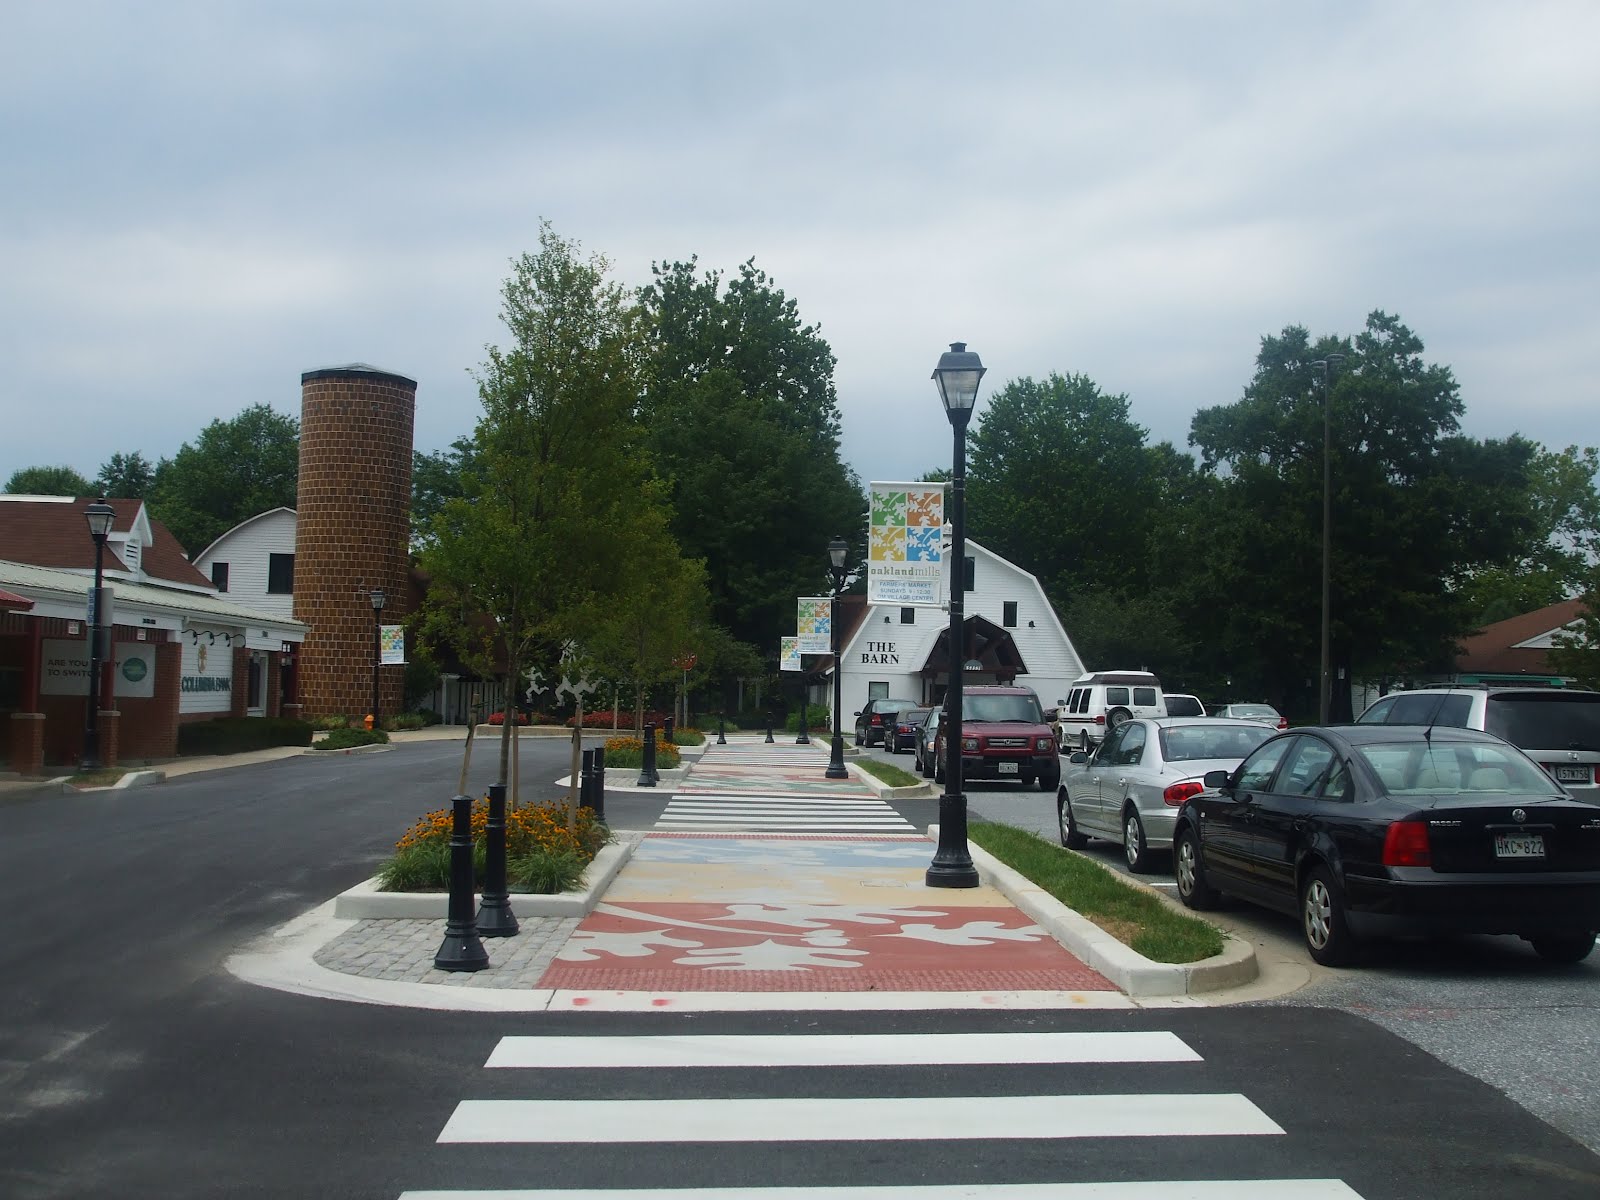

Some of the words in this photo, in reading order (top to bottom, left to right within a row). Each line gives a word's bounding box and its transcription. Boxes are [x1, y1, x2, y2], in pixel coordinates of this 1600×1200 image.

[870, 566, 940, 577] oaklandmills
[867, 641, 896, 653] THE
[47, 659, 66, 667] ARE
[68, 660, 89, 668] YOU
[861, 653, 900, 665] BARN
[47, 668, 61, 677] TO
[62, 669, 93, 678] SWITC
[1497, 840, 1517, 855] HKC
[1524, 840, 1544, 854] 822
